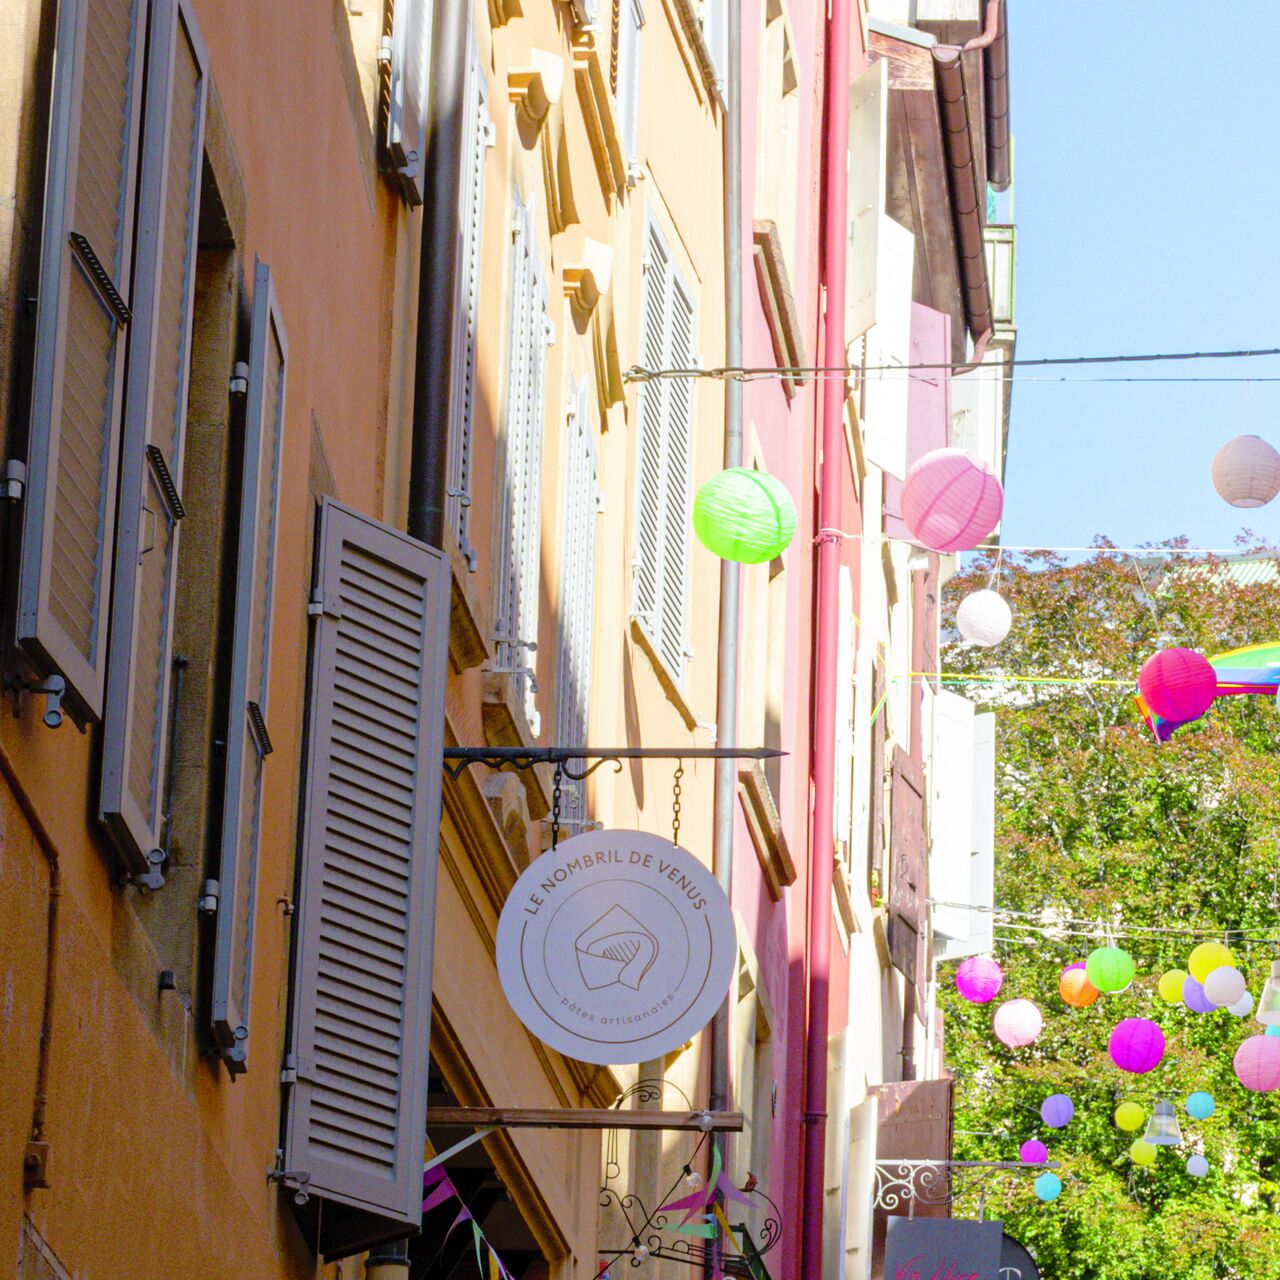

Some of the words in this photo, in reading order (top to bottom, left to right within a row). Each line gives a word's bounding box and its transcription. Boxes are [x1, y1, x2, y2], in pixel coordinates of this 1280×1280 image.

[524, 893, 544, 916] LE
[540, 849, 623, 894] NOMBRIL
[629, 851, 654, 868] DE
[658, 859, 708, 911] VENUS
[560, 996, 596, 1022] pâtes
[601, 994, 675, 1025] artisanales
